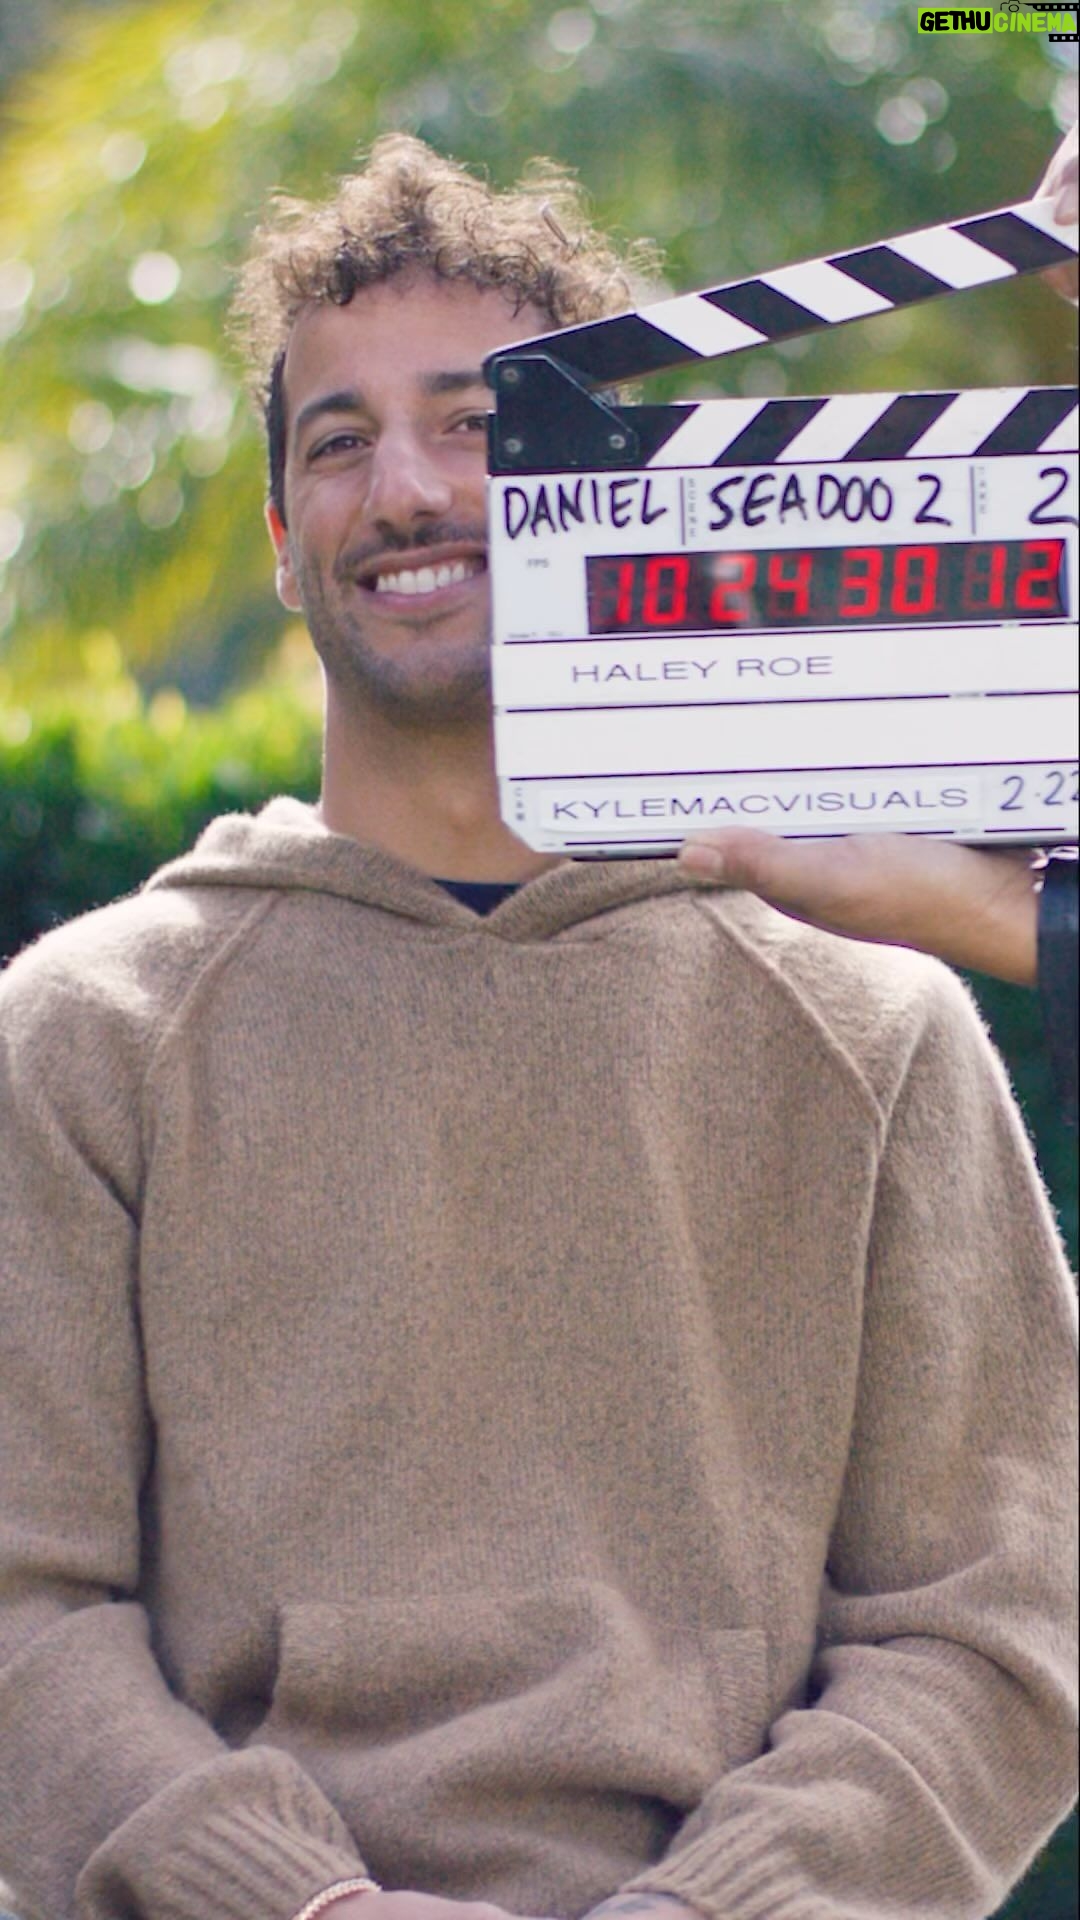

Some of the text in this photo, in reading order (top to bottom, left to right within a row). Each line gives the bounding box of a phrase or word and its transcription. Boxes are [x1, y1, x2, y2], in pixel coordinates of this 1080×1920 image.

[503, 478, 669, 540] DANIEL
[708, 474, 893, 530] SEADOO
[914, 474, 951, 527] 2
[1028, 466, 1079, 528] 2
[572, 656, 833, 683] HALEY ROE
[553, 788, 968, 820] KYLEMACVISUALS
